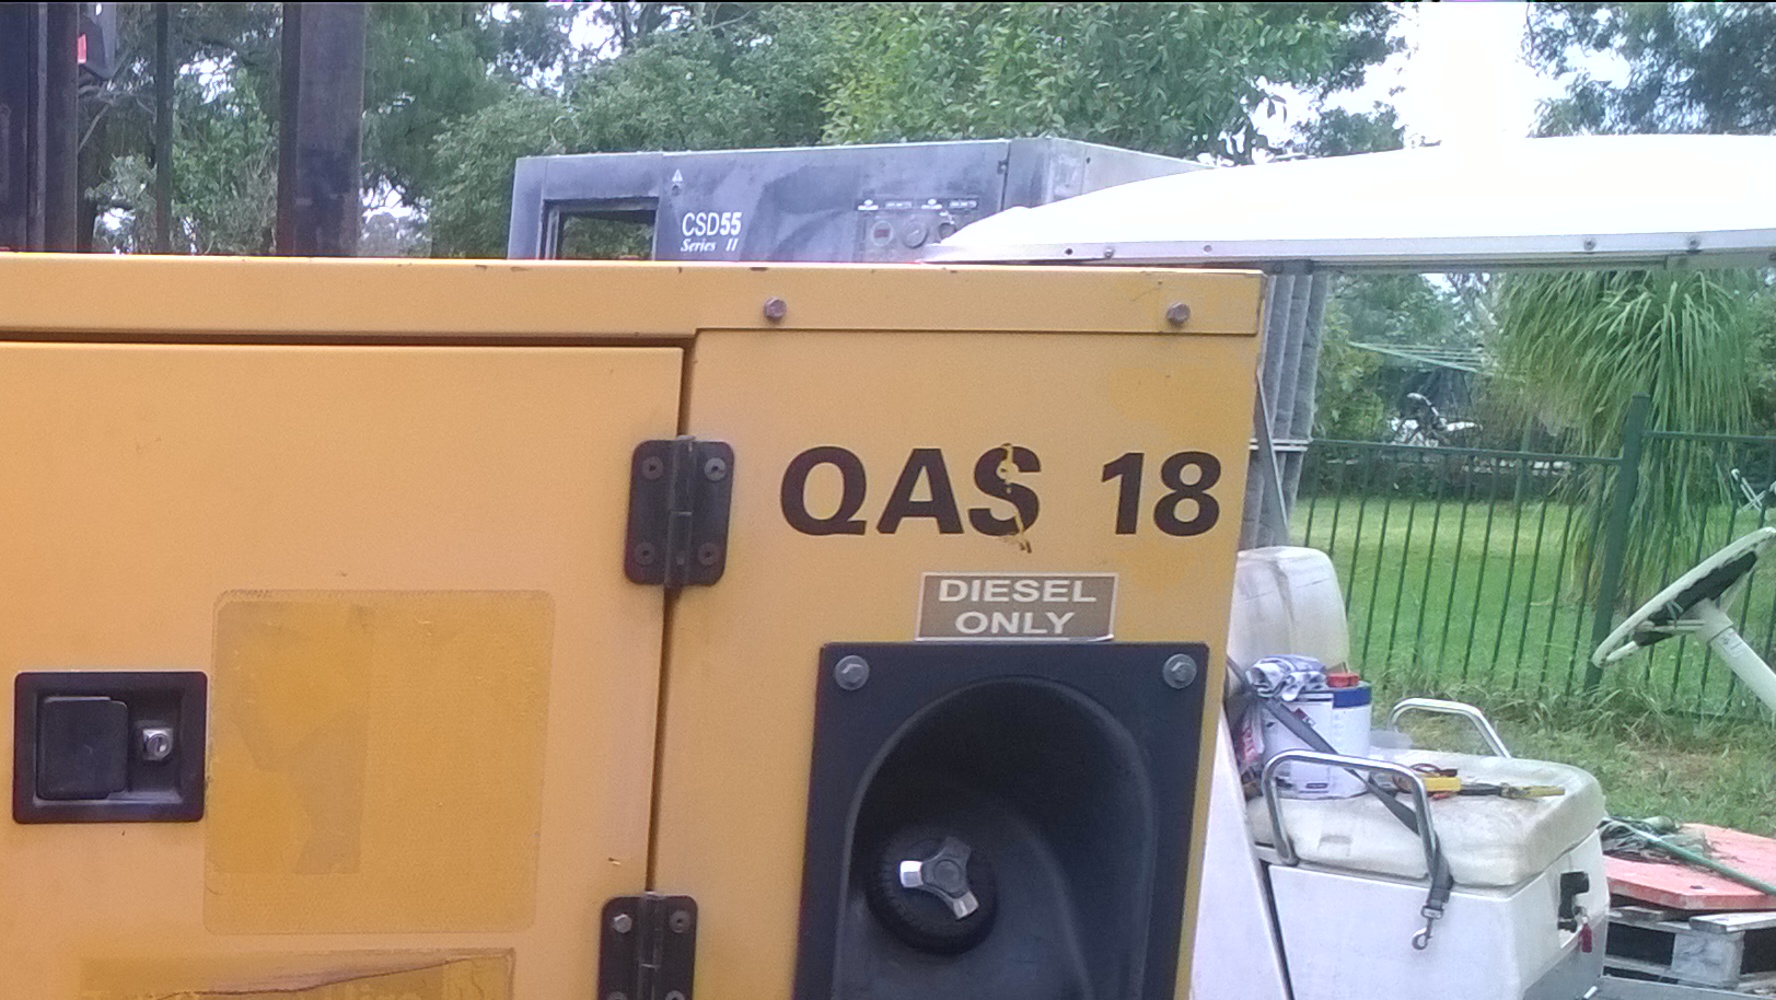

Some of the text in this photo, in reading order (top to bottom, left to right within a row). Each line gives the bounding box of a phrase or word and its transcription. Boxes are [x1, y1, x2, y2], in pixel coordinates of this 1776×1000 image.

[682, 211, 743, 237] CSD55
[680, 238, 717, 252] Series
[780, 444, 1223, 537] QAS 18
[938, 579, 1098, 603] DIESEL
[954, 611, 1075, 635] ONLY
